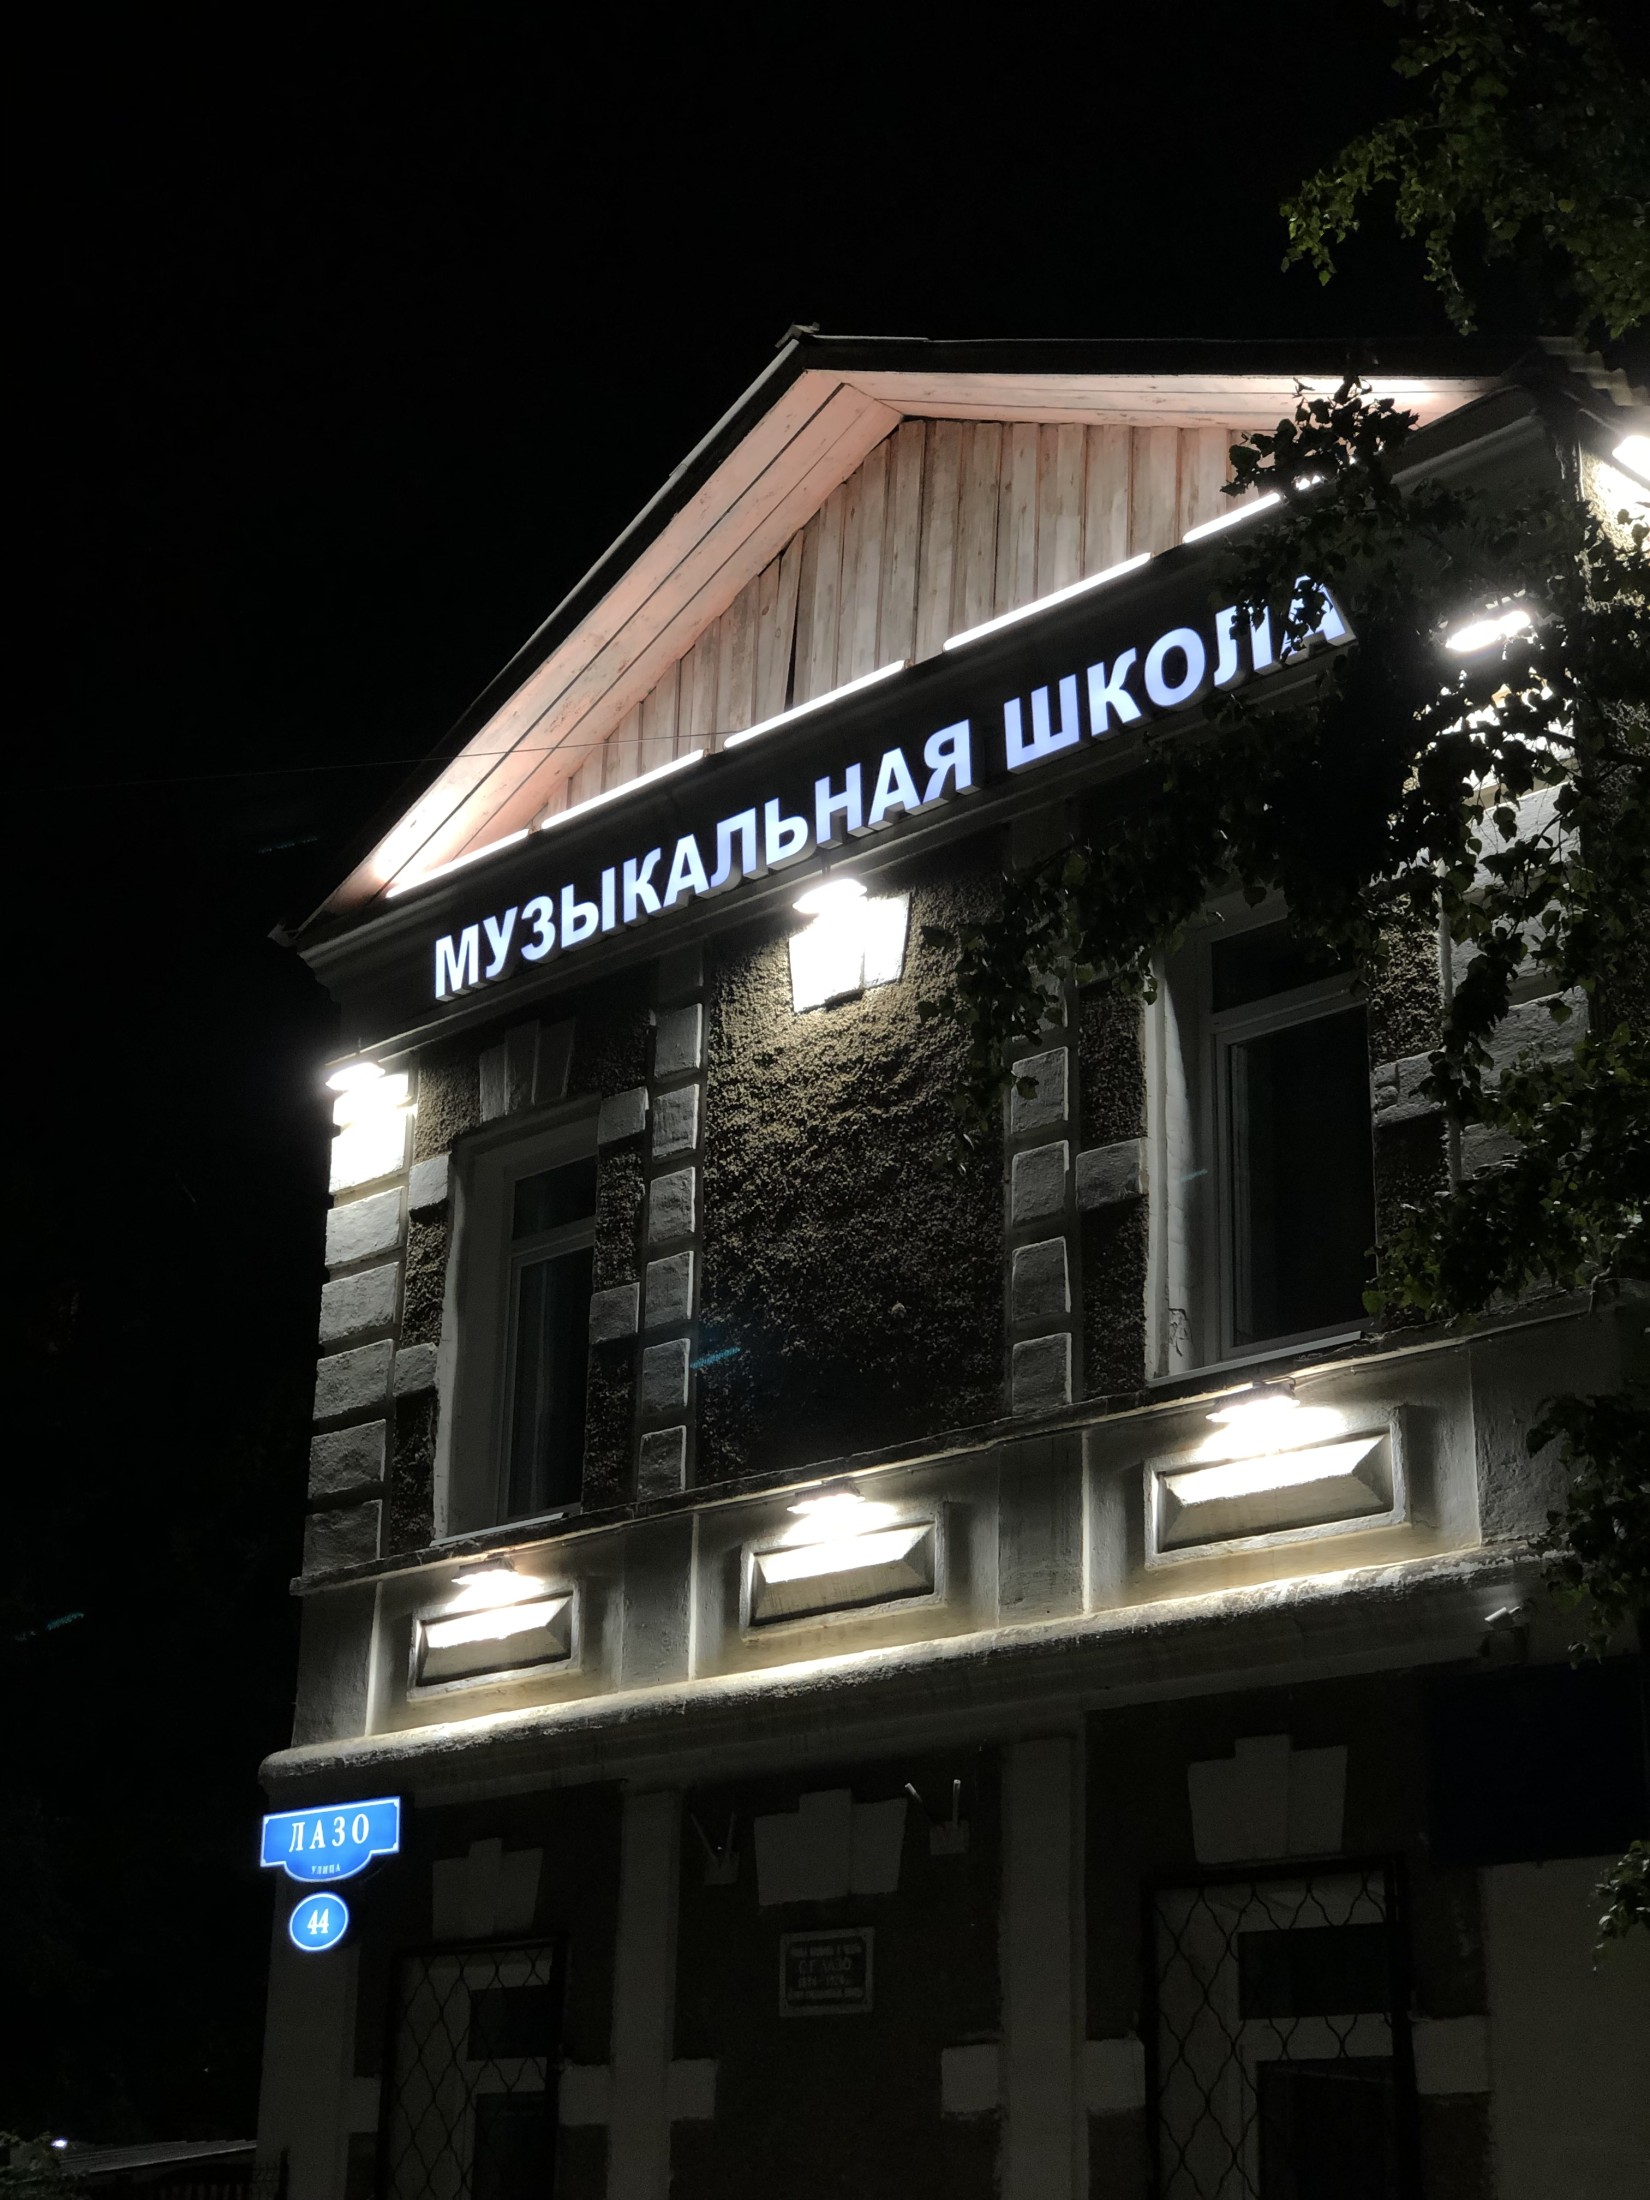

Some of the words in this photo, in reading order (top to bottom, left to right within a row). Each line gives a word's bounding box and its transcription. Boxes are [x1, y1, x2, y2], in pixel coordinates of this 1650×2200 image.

[434, 718, 974, 1001] МУЗЫКАЛЬНАЯ
[288, 1813, 370, 1853] ЛАЗО
[307, 1908, 330, 1935] 44
